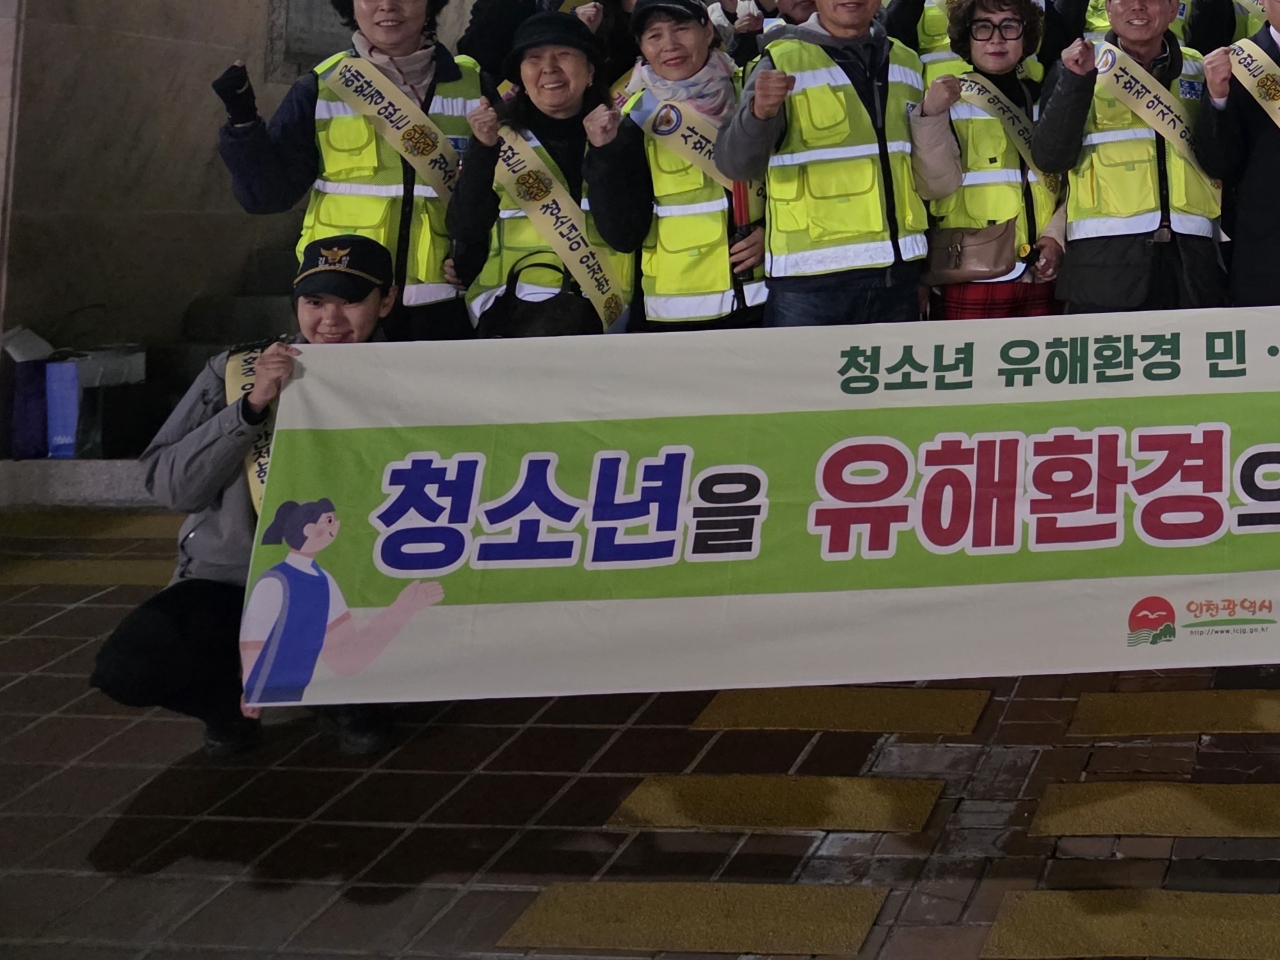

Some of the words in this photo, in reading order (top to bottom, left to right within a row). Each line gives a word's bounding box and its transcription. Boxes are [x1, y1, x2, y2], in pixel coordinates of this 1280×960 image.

[1112, 65, 1152, 101] 사회적
[1145, 93, 1184, 130] 약자가
[1237, 52, 1266, 79] 없는
[339, 64, 386, 106] 유해환경
[376, 100, 412, 131] 없는
[402, 123, 438, 157] 인천
[986, 94, 1022, 127] 약자가
[516, 169, 552, 202] 인천
[539, 198, 590, 252] 청소년이
[578, 250, 612, 296] 안전한
[837, 341, 976, 395] 청소년
[997, 330, 1182, 388] 유해환경
[372, 447, 766, 574] 청소년을
[1185, 598, 1274, 619] 인천광역시
[1189, 626, 1269, 636] http://www.icjg.go.kr
